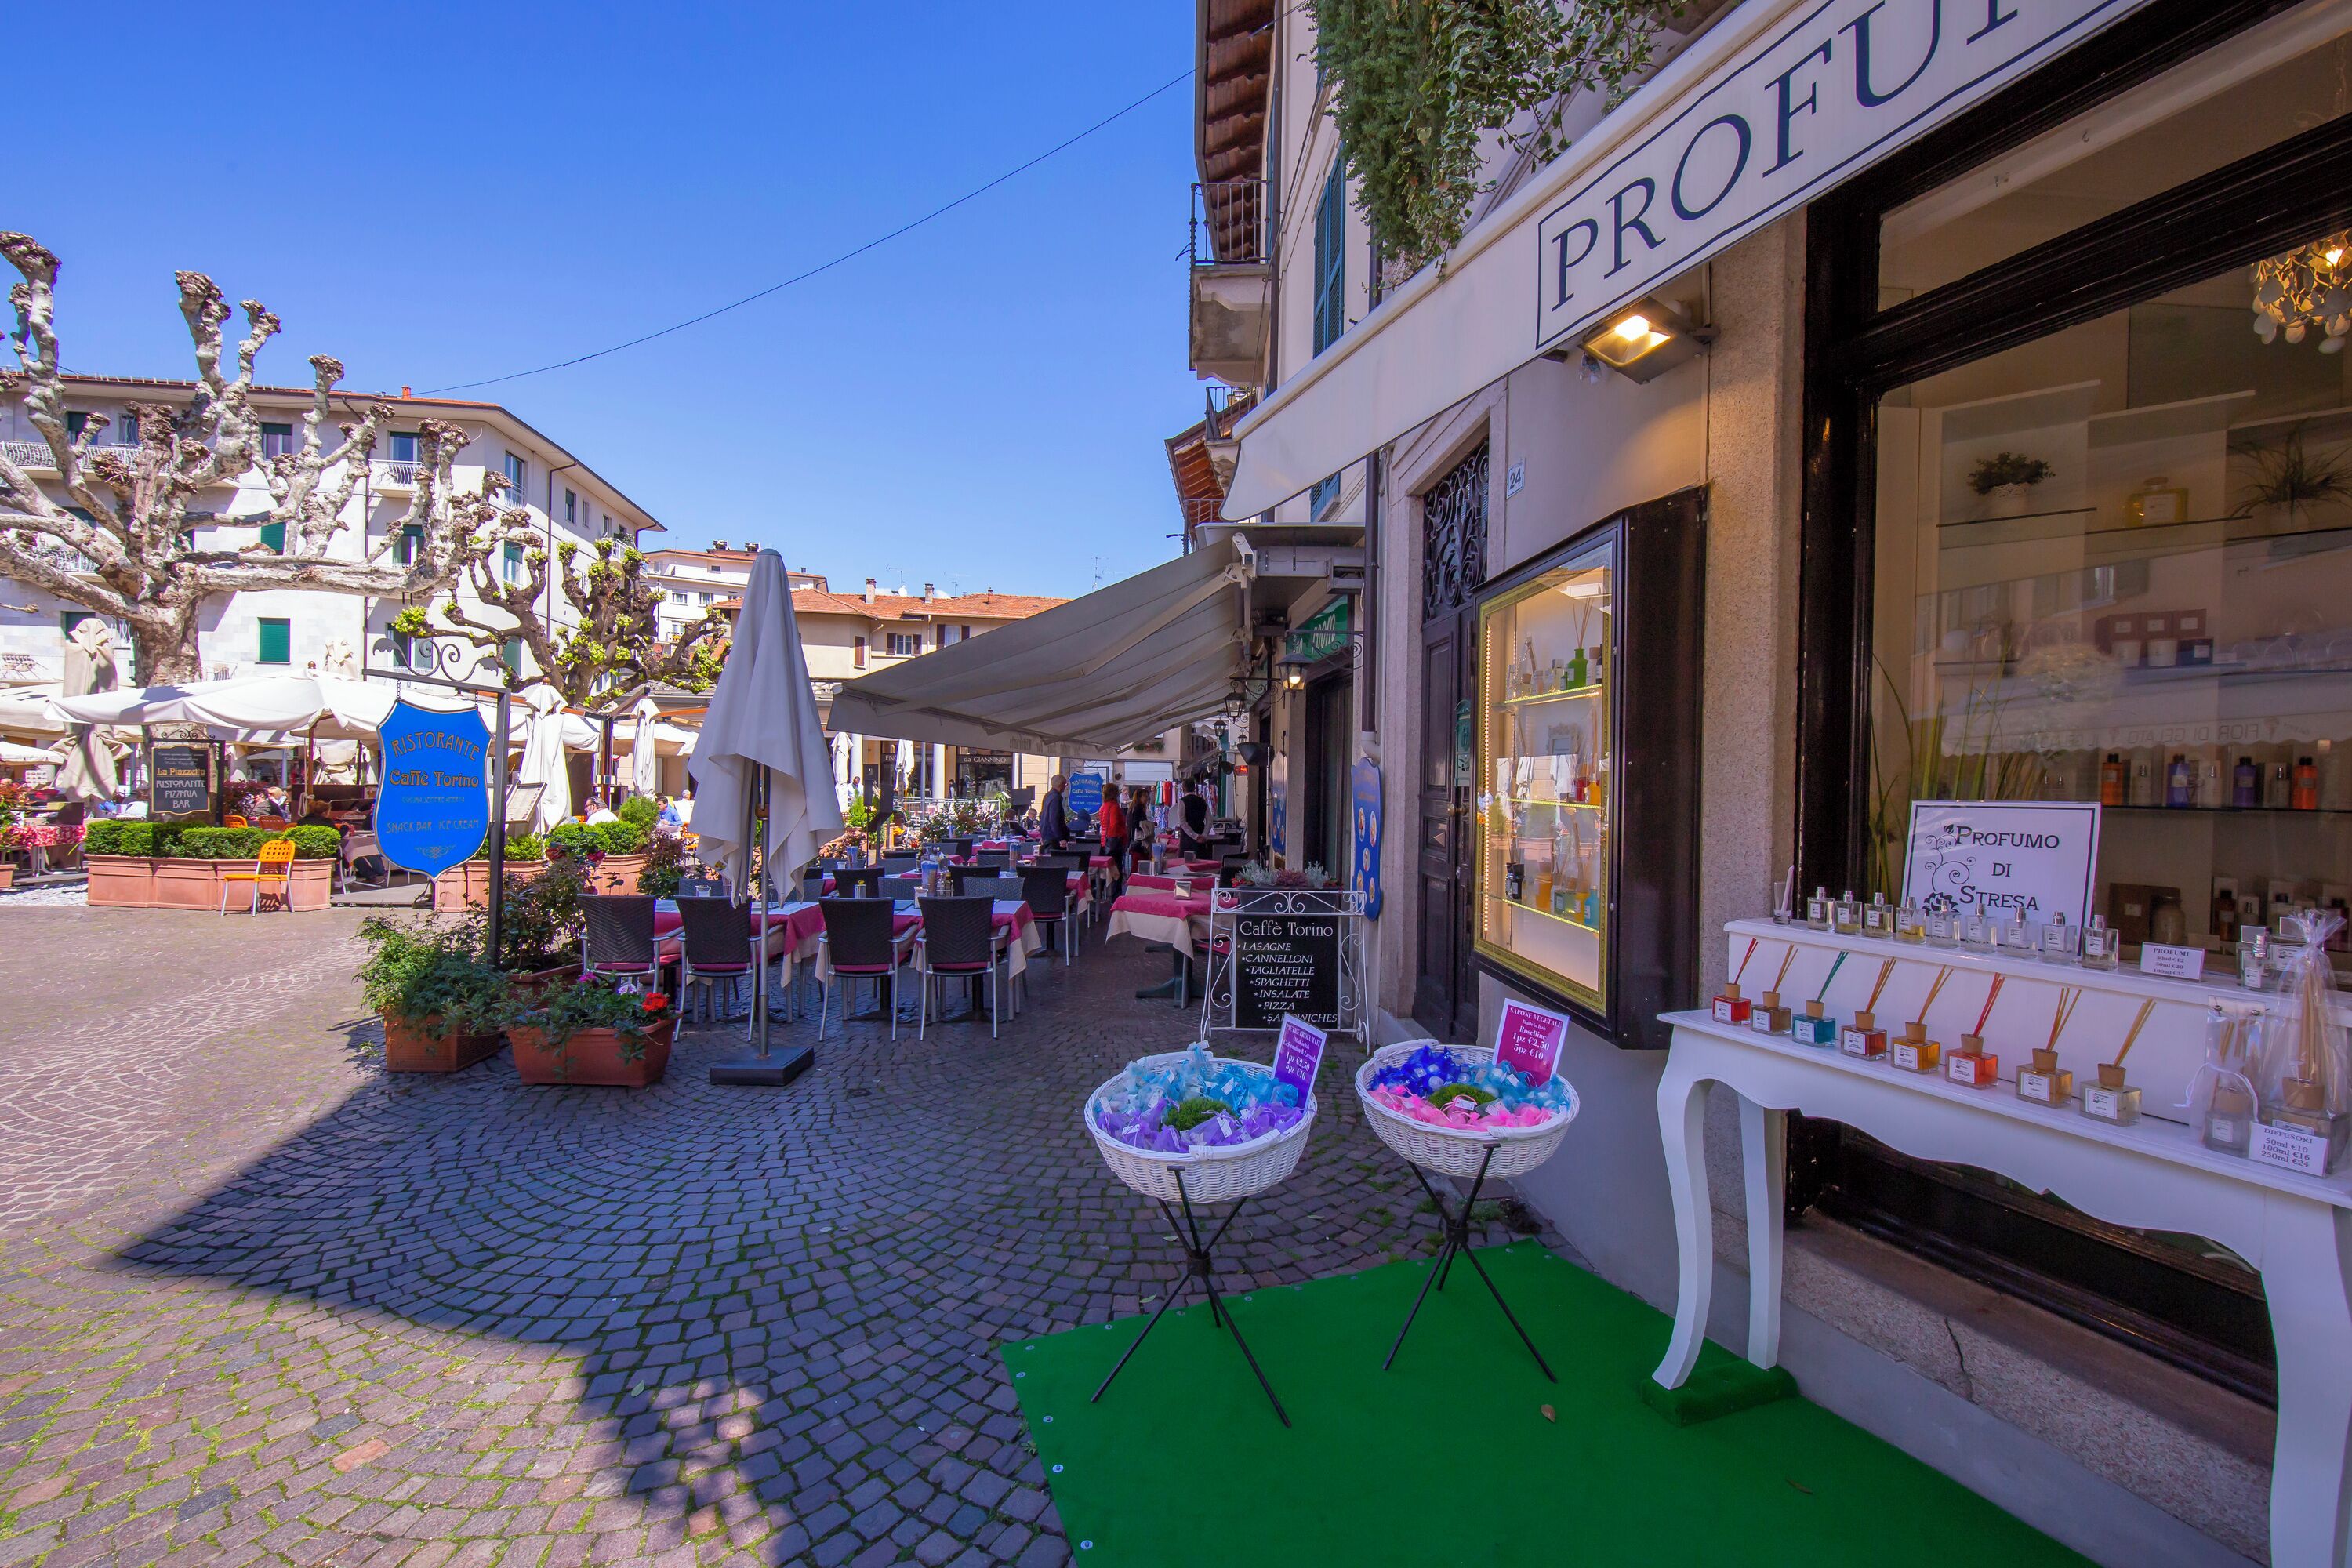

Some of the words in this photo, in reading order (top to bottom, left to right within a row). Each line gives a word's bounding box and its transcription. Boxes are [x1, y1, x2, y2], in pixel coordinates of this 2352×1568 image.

[1552, 0, 2019, 312] PROFU
[1510, 468, 1521, 490] 24
[391, 731, 481, 762] RISTORANTE
[157, 780, 206, 789] RISTORANTE
[390, 769, 430, 786] Caffè
[433, 771, 479, 788] Torino
[172, 800, 190, 808] BAR
[386, 821, 414, 833] SNACK
[417, 821, 432, 833] BAR
[439, 820, 451, 830] ICE
[454, 819, 480, 830] CREAM
[1955, 826, 2060, 849] PROFUMO
[1991, 862, 2013, 877] DI
[1240, 920, 1283, 936] Caffè
[1287, 921, 1334, 937] Torino
[1243, 942, 1292, 951] LASAGNE
[2154, 947, 2189, 956] PROFUMI
[1246, 954, 1313, 964] CANNELLONI
[1250, 966, 1315, 975] TAGLIATELLE
[1254, 978, 1310, 987] SPAGHETTI
[1259, 989, 1310, 999] INSALATE
[1263, 1001, 1295, 1011] PIZZA
[1267, 1013, 1338, 1022] SAWICHES
[1510, 1007, 1533, 1019] SAPONE
[1534, 1014, 1563, 1028] VEGETALE
[1513, 1032, 1526, 1043] 1pz
[1528, 1036, 1550, 1051] €2,50
[1286, 1051, 1295, 1064] 1pz
[1513, 1044, 1527, 1054] 5pz
[1529, 1049, 1544, 1060] €10
[1296, 1068, 1306, 1080] €10
[2264, 1128, 2313, 1143] DIFFUSORI
[2263, 1144, 2289, 1156] 100ml
[2293, 1152, 2310, 1160] €16
[2266, 1138, 2288, 1148] 50ml
[2291, 1144, 2308, 1153] €10
[2261, 1151, 2289, 1163] 250ml
[2292, 1159, 2309, 1167] €24
